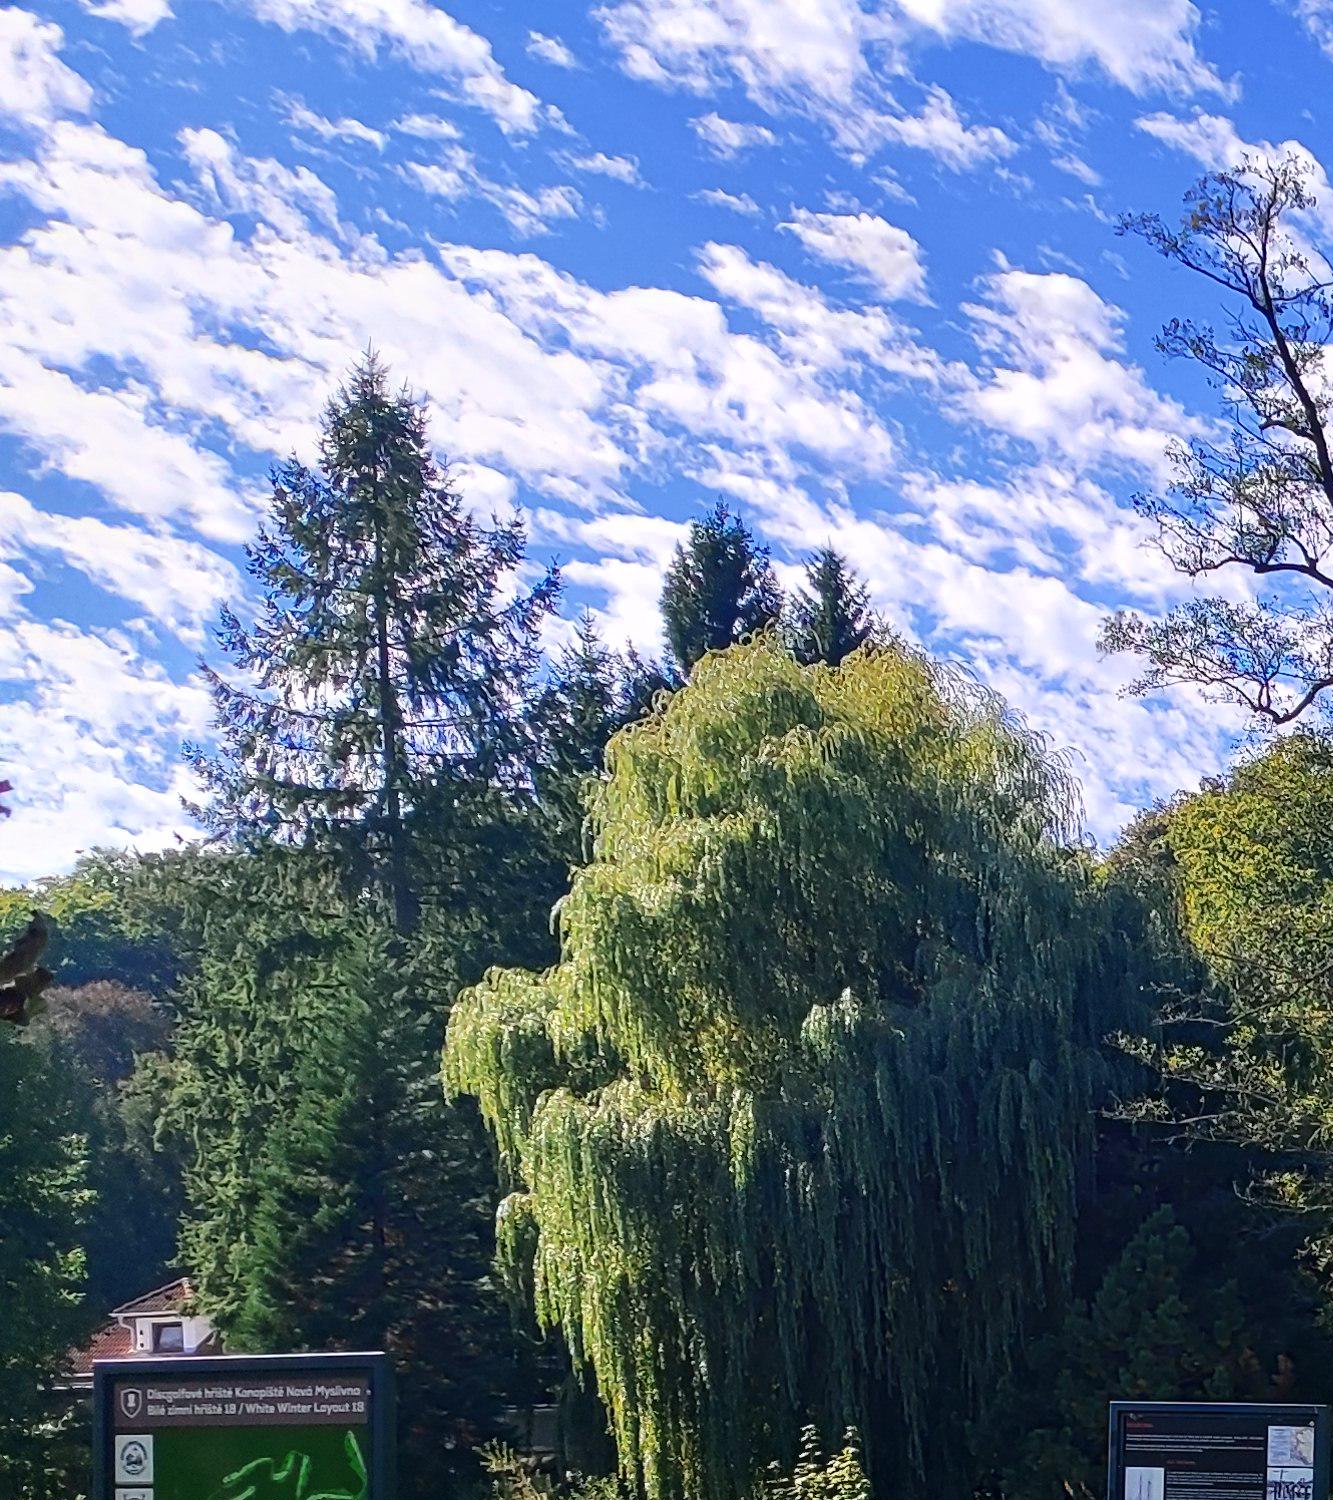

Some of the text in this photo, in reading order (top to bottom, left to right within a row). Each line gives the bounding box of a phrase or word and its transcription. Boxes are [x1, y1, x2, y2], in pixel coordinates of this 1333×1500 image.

[286, 1385, 313, 1397] Nová
[224, 1403, 237, 1414] 18
[245, 1403, 275, 1414] White
[277, 1402, 312, 1413] Winter
[313, 1402, 349, 1415] Layout
[352, 1401, 364, 1412] 18
